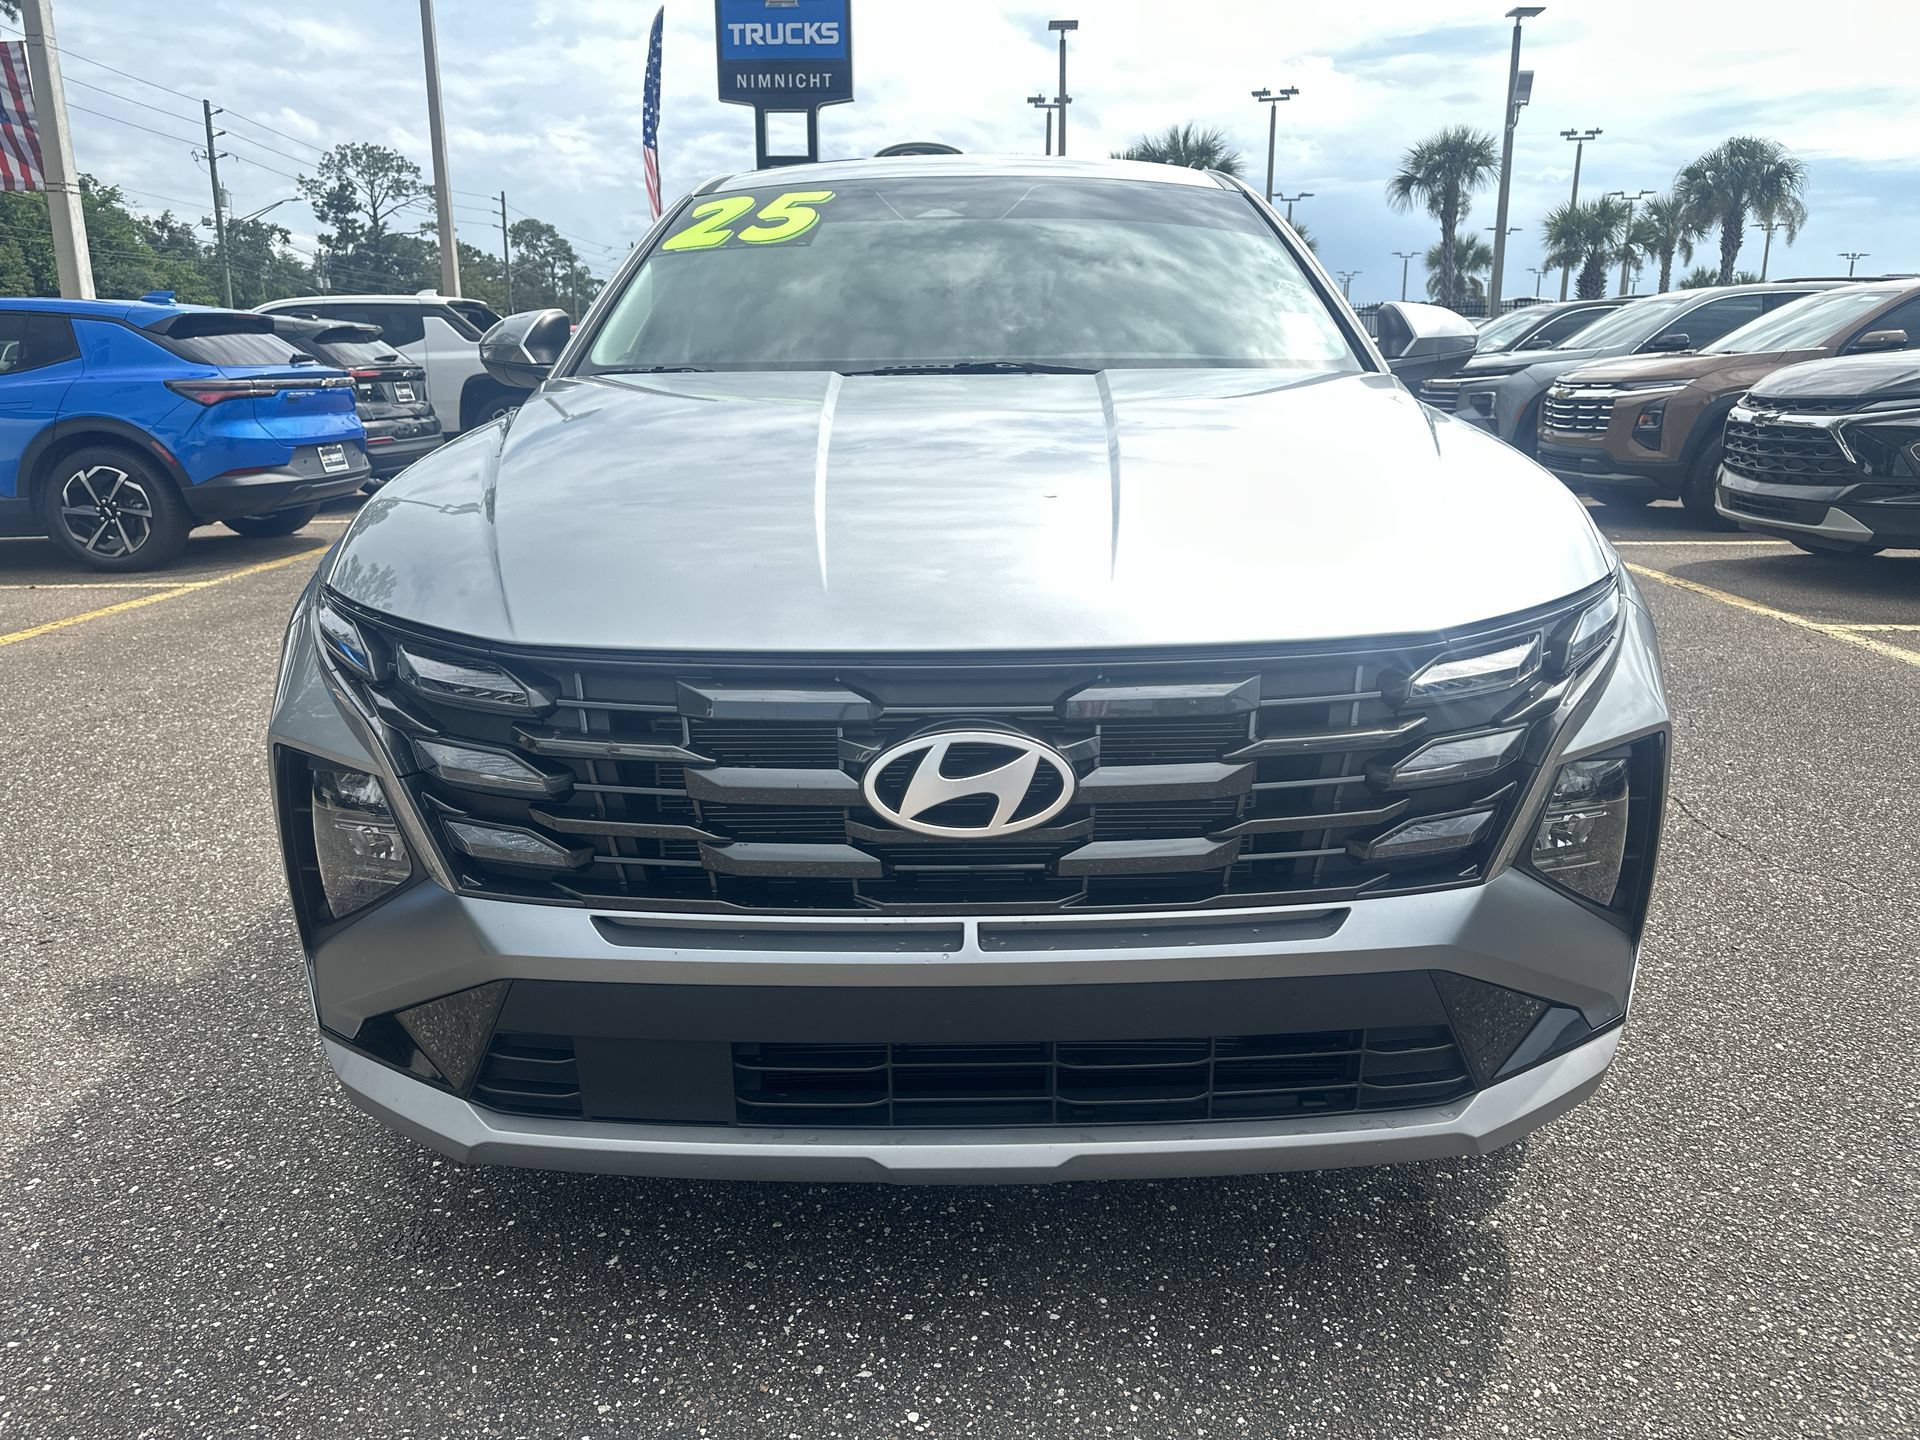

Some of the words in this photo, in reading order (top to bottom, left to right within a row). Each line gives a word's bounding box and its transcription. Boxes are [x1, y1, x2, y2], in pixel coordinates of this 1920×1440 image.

[728, 22, 839, 46] TRUCKS
[736, 73, 832, 89] NIMNICHT
[661, 190, 836, 252] 25
